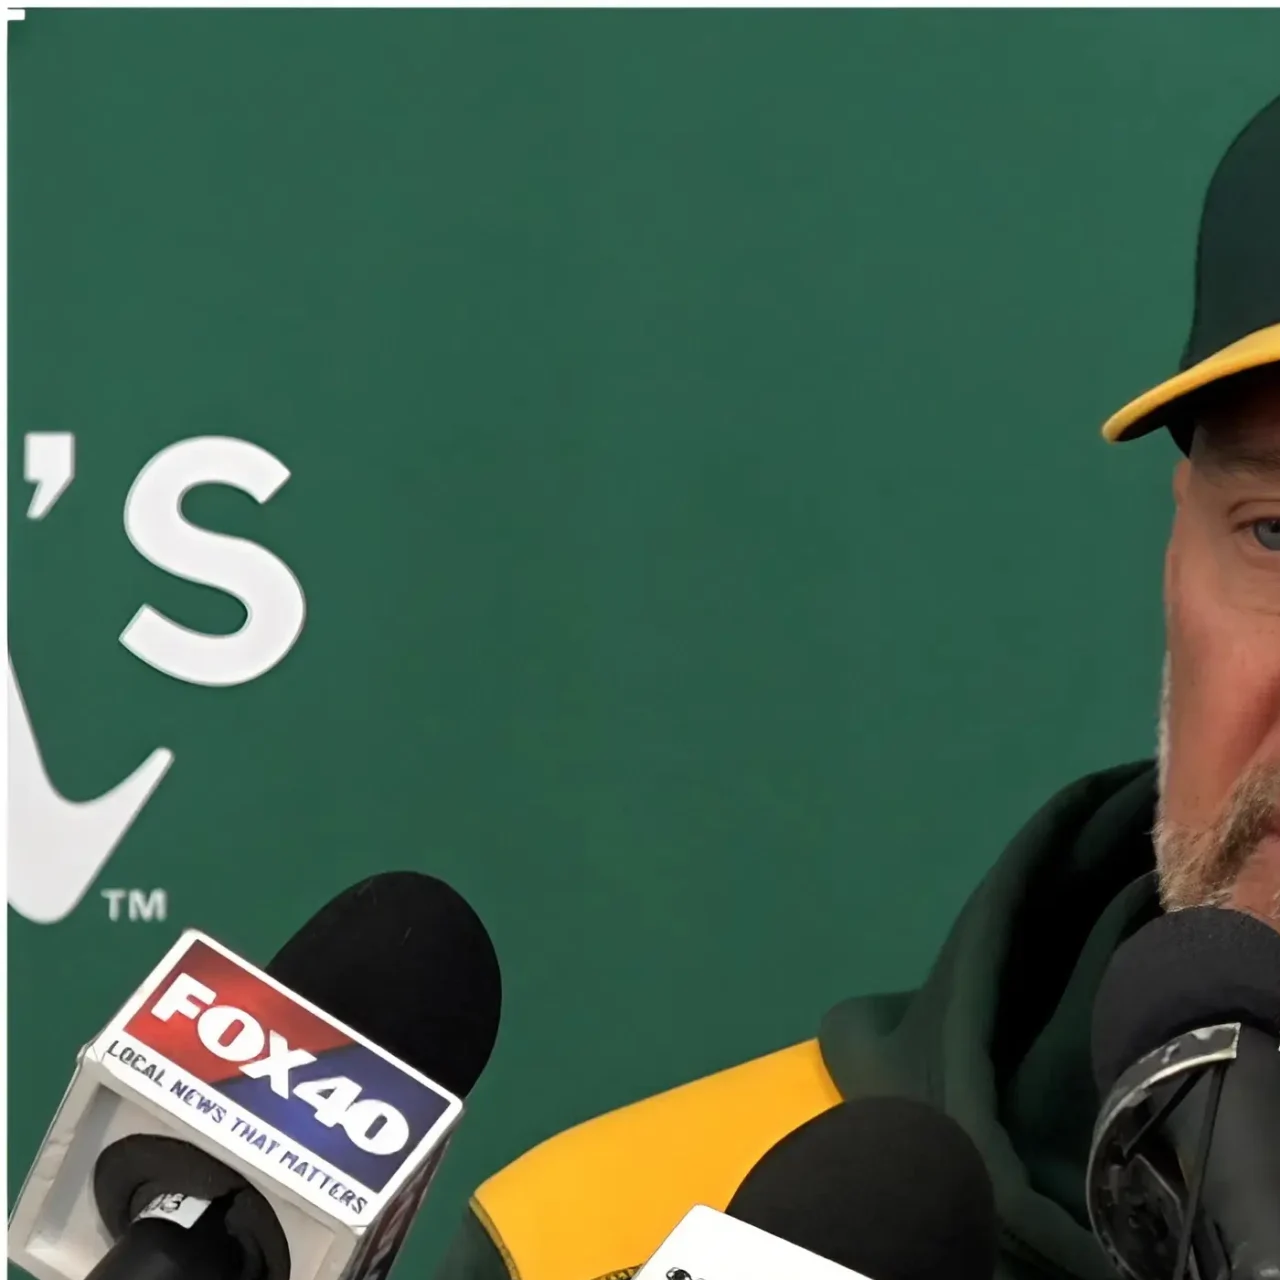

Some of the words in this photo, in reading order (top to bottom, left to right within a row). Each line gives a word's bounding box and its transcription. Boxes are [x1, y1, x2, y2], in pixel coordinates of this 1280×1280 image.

[101, 889, 167, 921] TM
[106, 1039, 165, 1088] LOCAL
[169, 1079, 228, 1124] NEWS
[230, 1116, 281, 1156] THAT
[279, 1150, 369, 1215] MATTERS
[150, 972, 410, 1156] FOX40
